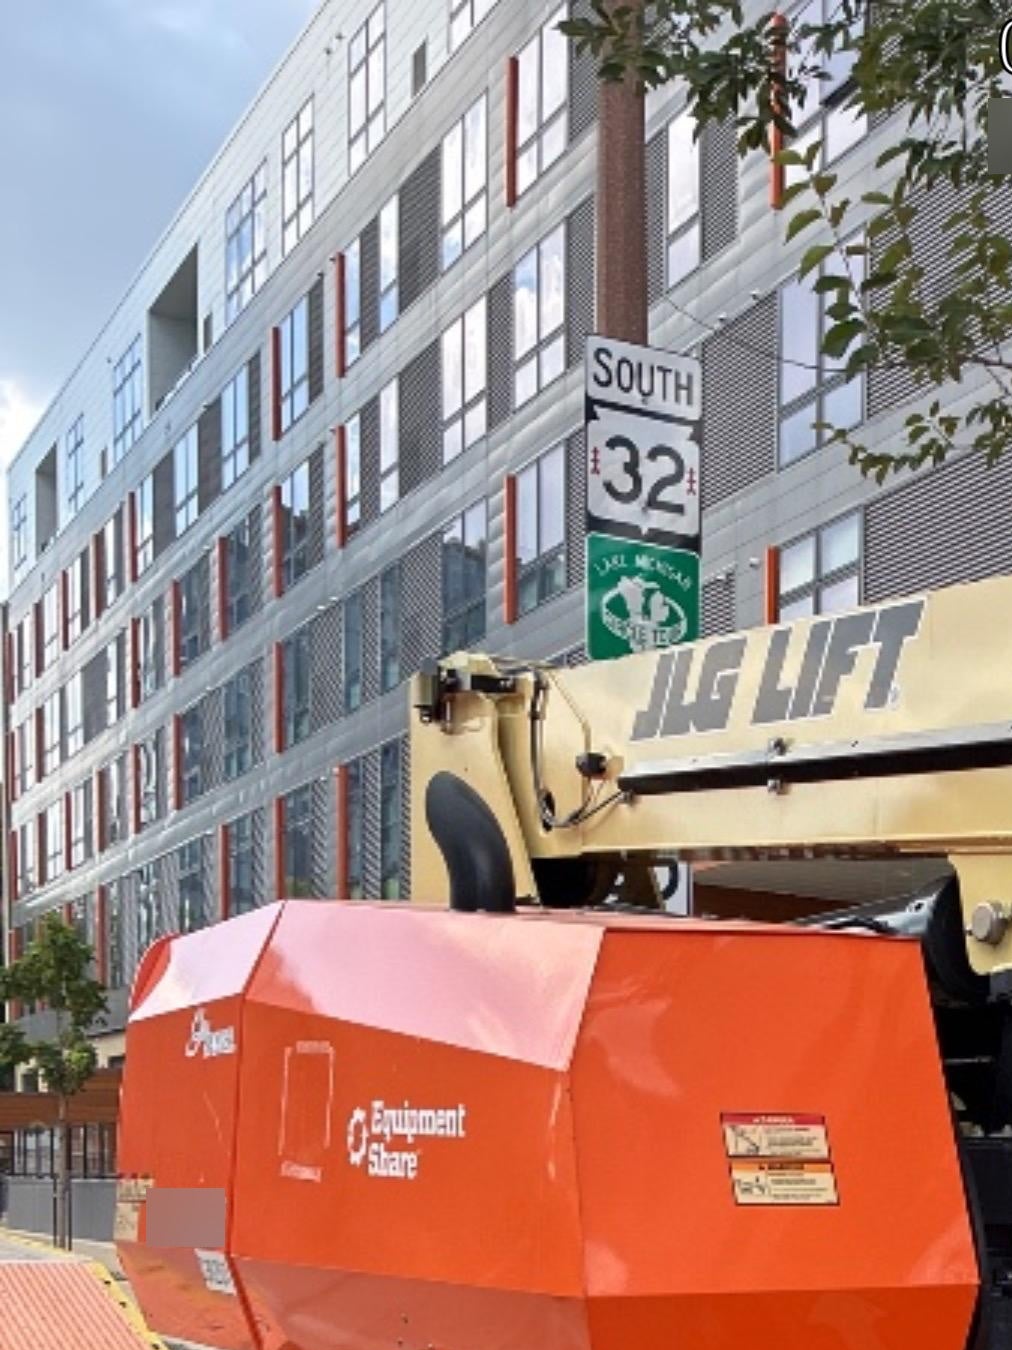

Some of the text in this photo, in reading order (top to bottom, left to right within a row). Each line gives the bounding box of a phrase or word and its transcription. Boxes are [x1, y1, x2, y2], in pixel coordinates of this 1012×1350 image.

[593, 347, 693, 407] SOUTH
[603, 434, 685, 517] 32
[629, 598, 927, 741] JLG LIFT
[371, 1099, 466, 1144] Equipment
[368, 1141, 419, 1180] Share
